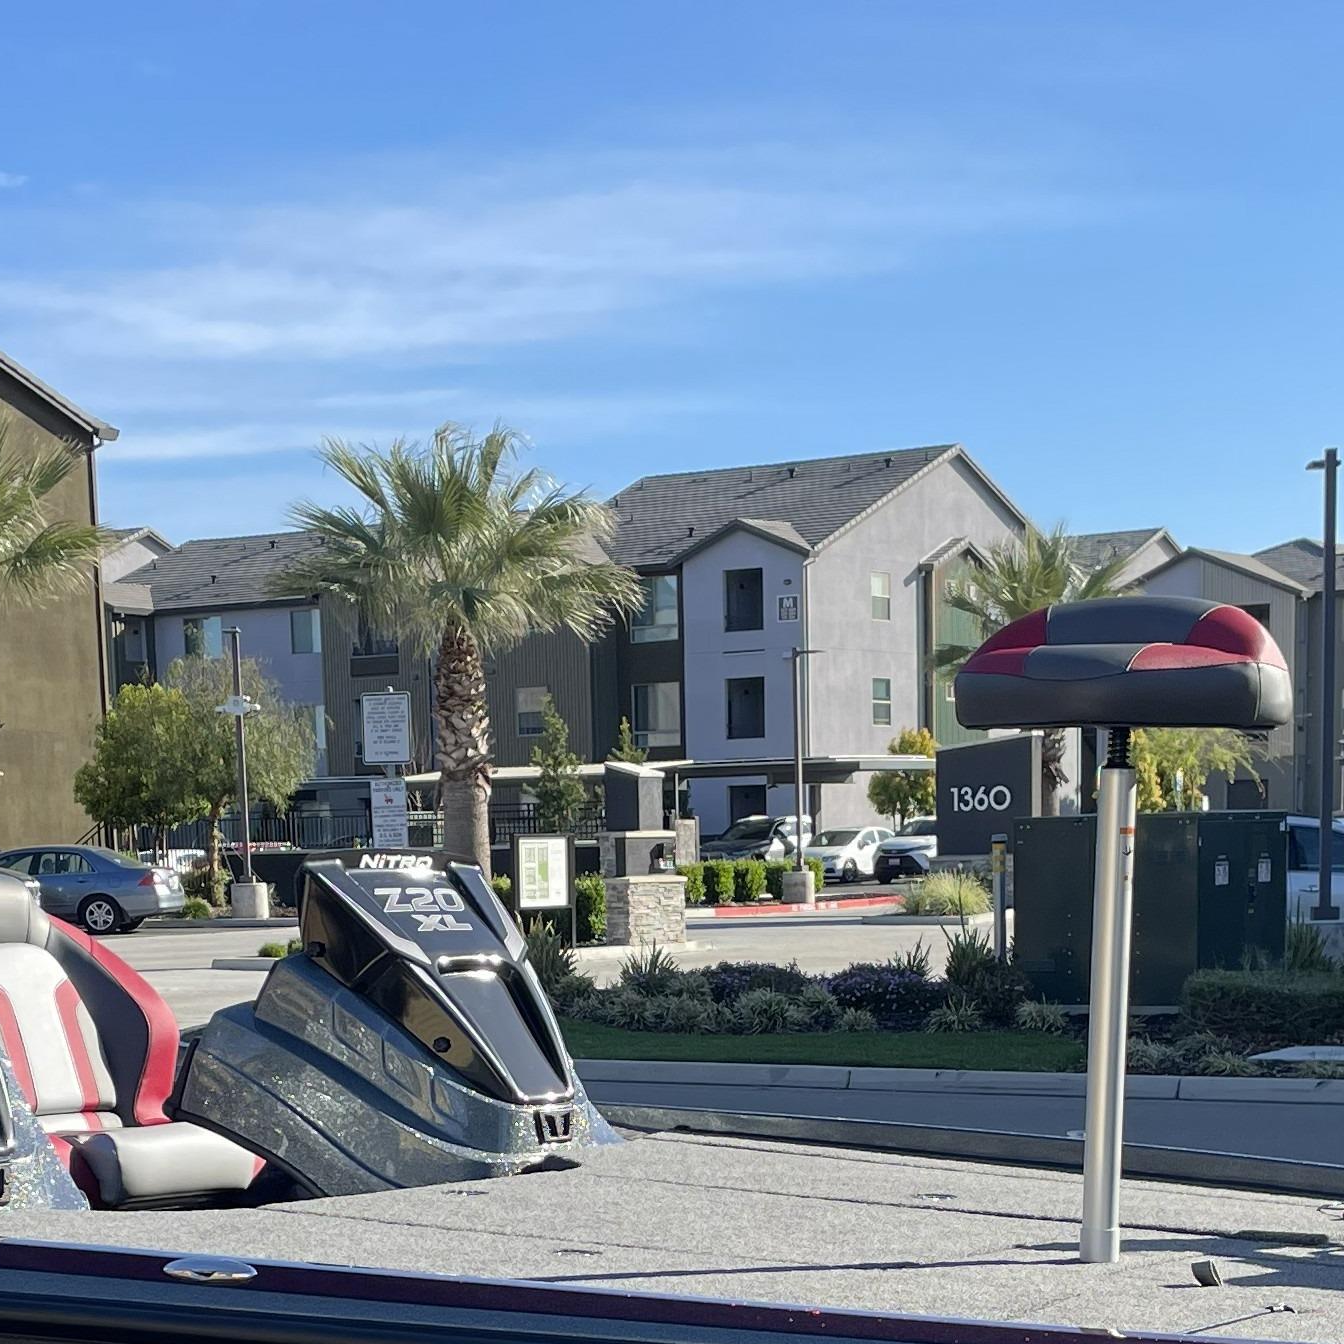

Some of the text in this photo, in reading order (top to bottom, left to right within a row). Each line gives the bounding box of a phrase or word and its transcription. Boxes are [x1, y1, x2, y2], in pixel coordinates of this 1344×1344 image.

[782, 598, 794, 608] M
[950, 785, 1012, 812] 1360
[374, 887, 465, 912] Z20
[411, 914, 473, 931] XL
